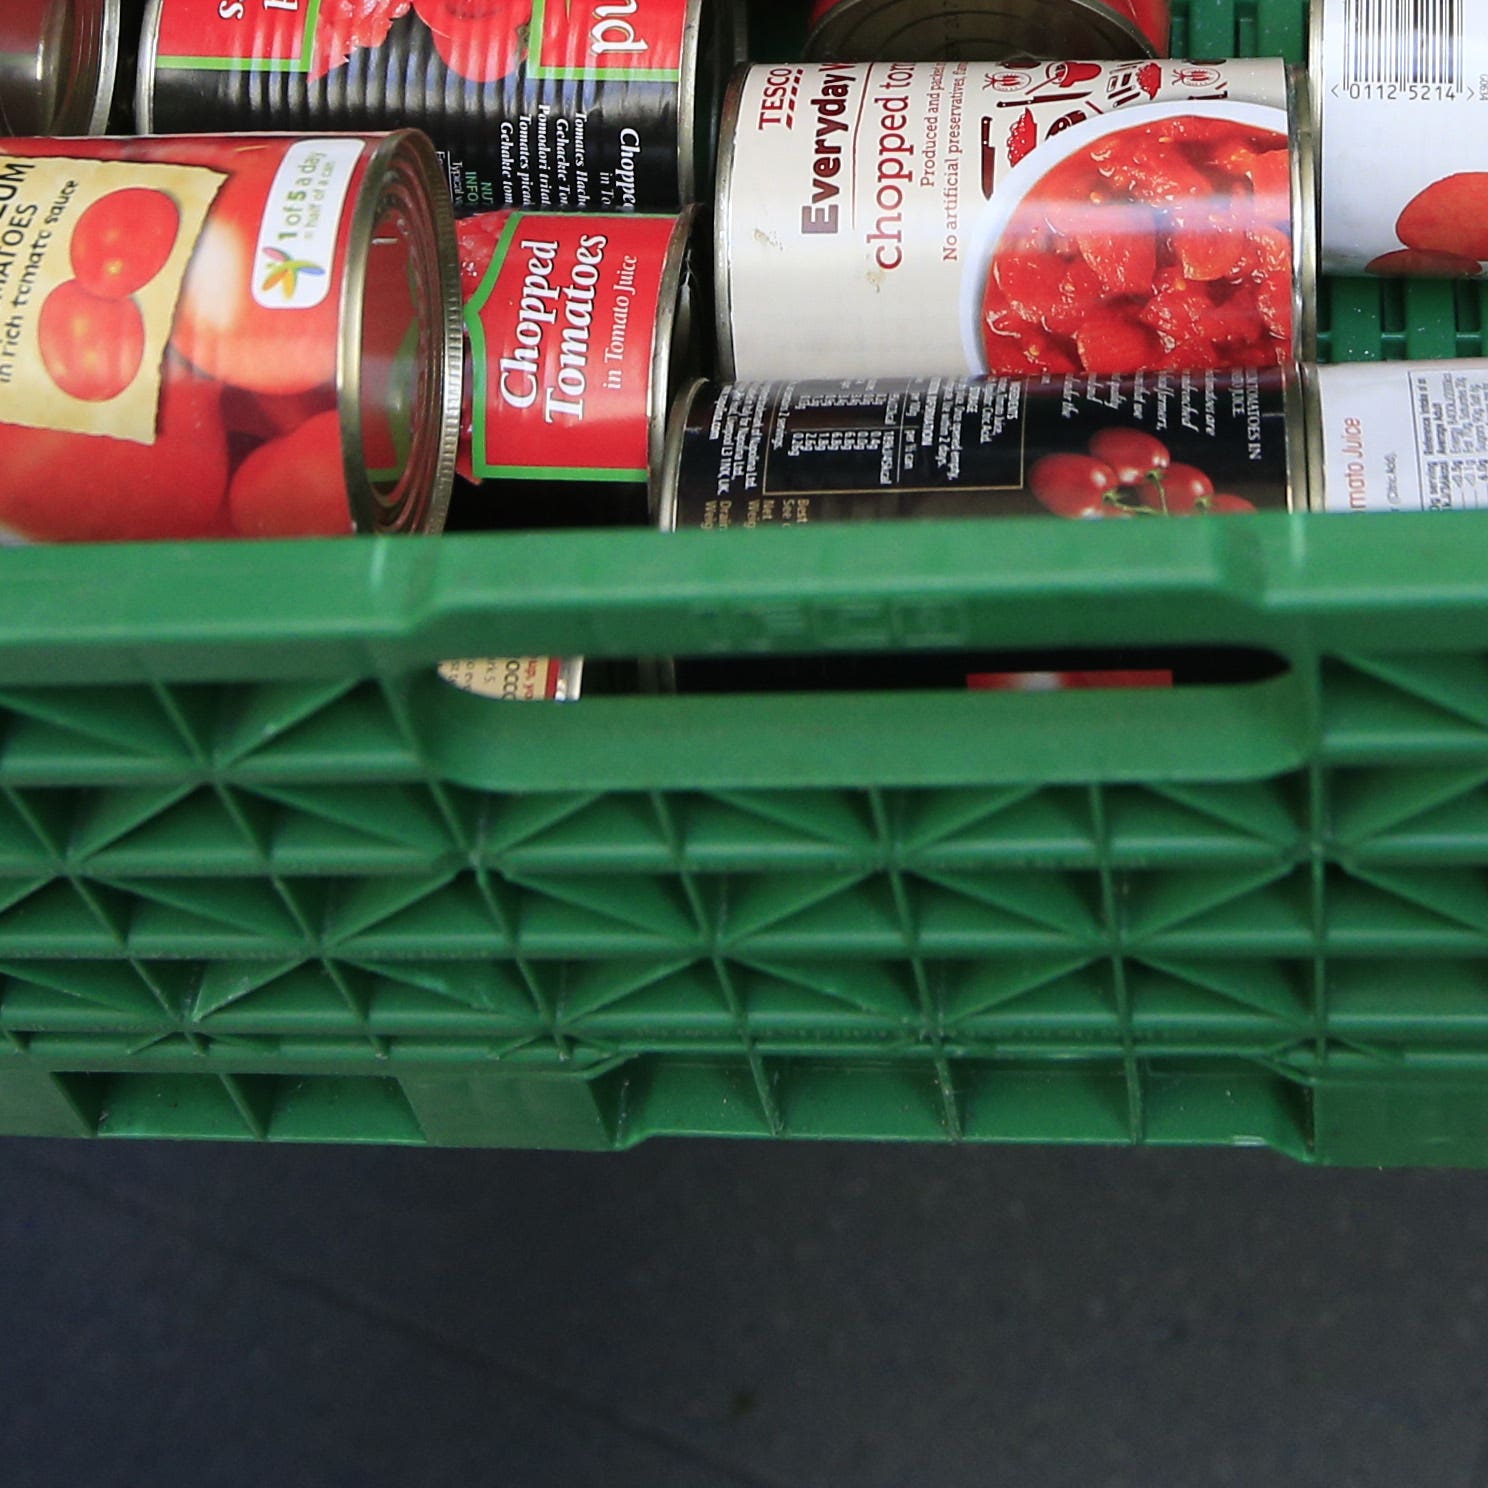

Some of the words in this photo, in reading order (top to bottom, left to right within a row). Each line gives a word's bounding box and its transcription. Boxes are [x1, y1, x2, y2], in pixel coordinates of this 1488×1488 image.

[758, 68, 793, 130] TESCO
[926, 93, 940, 113] and
[945, 77, 967, 154] preservatives,
[1349, 84, 1397, 100] 0112
[1409, 85, 1456, 100] 5214
[298, 152, 326, 174] day
[500, 122, 514, 177] Gehakte
[519, 114, 533, 169] Tomates
[537, 104, 551, 169] Pomodori
[555, 119, 570, 181] Gehackte
[575, 112, 588, 166] Tomates
[801, 73, 856, 234] Everyday
[920, 117, 937, 187] Produced
[286, 191, 306, 201] 5
[296, 178, 312, 186] a
[450, 162, 465, 193] Typical
[866, 95, 914, 270] chopped
[944, 158, 958, 230] artificial
[11, 231, 52, 306] tomato
[43, 180, 78, 224] sauce
[283, 207, 302, 226] of
[612, 255, 638, 294] Juice
[943, 235, 958, 261] No
[499, 240, 559, 409] Chopped
[544, 234, 607, 424] Tomatoes
[604, 294, 630, 365] Tomato
[602, 373, 622, 391] in
[1341, 418, 1363, 458] Juice
